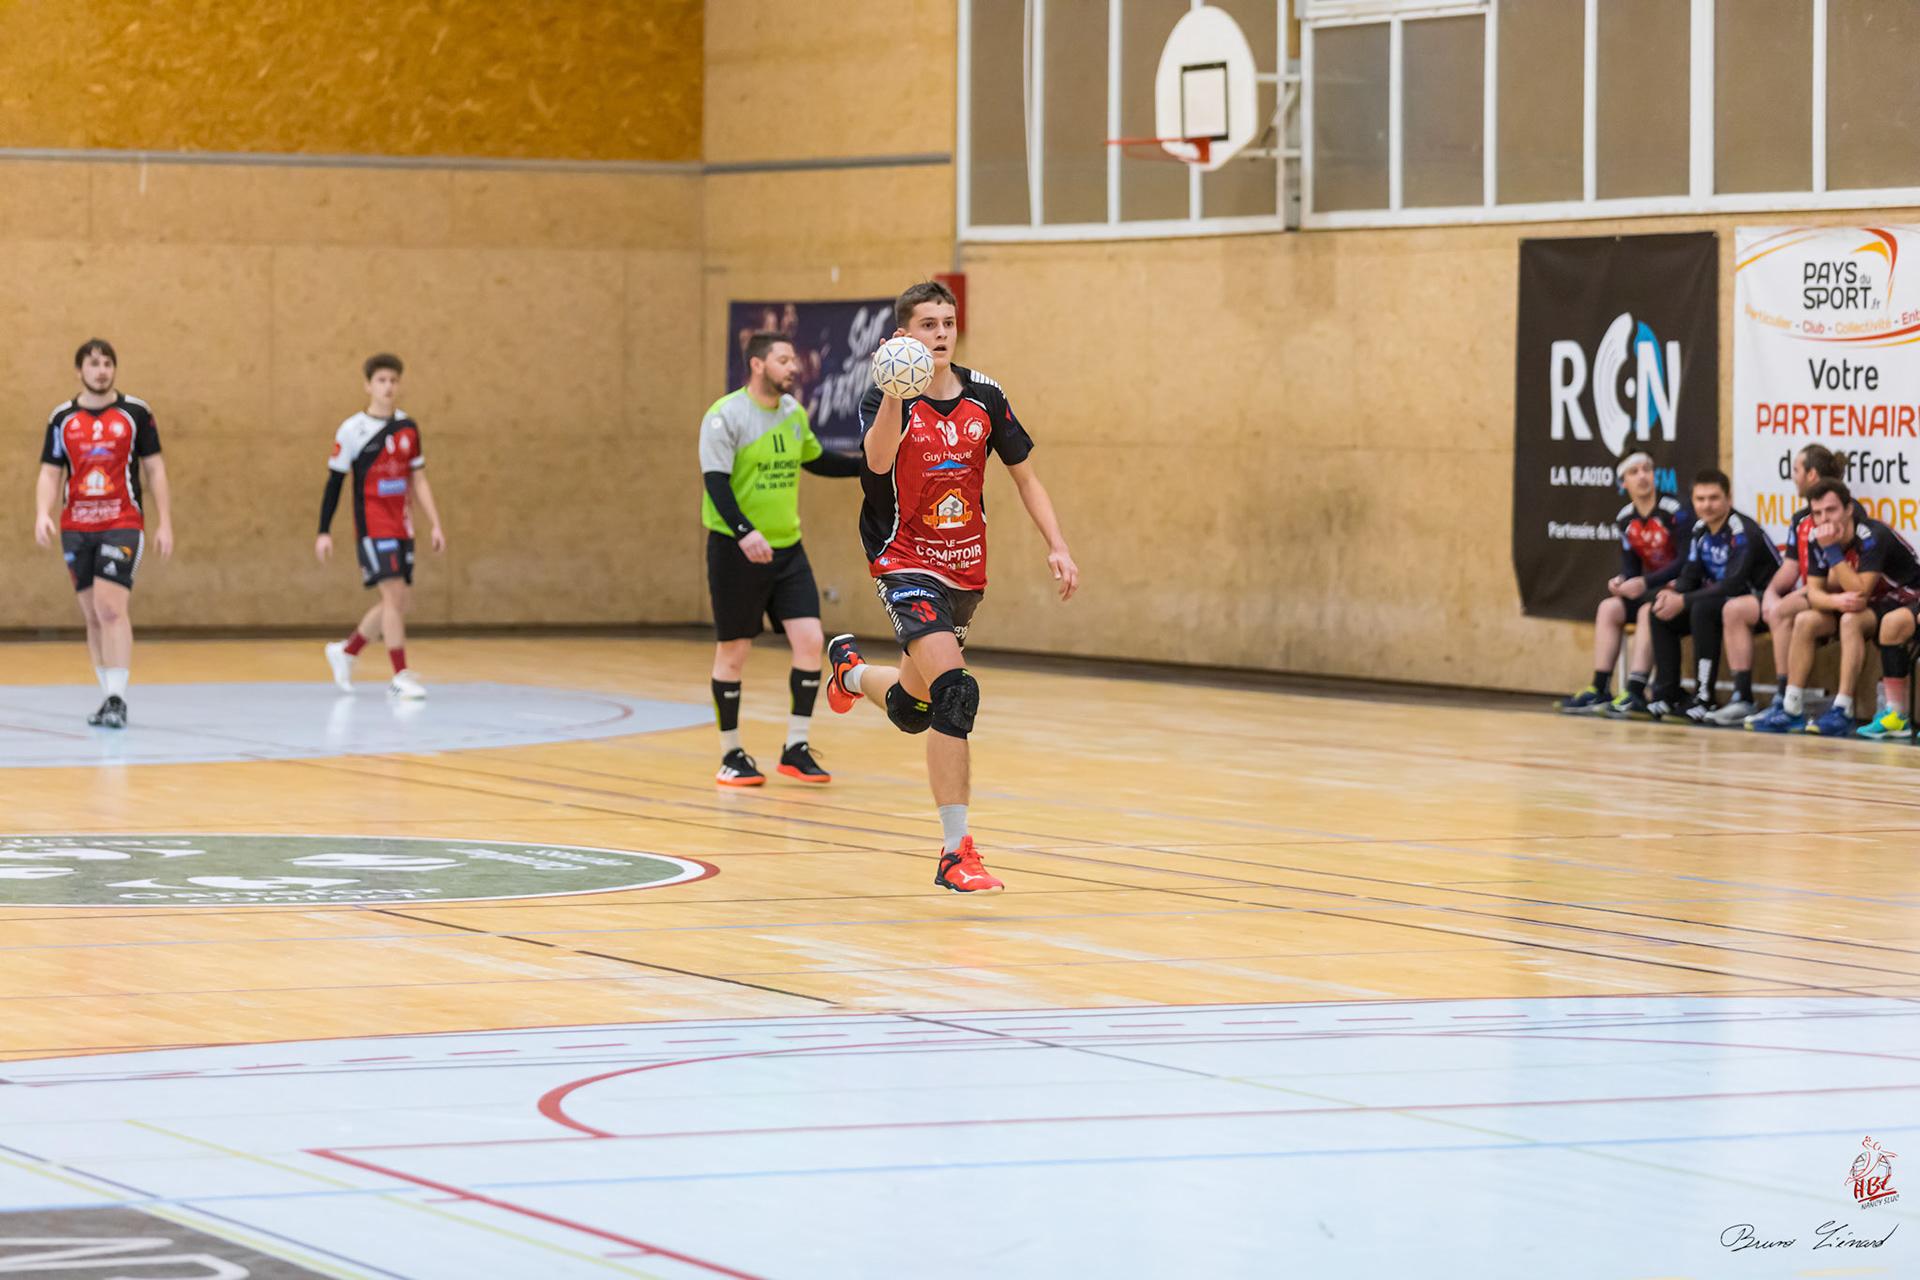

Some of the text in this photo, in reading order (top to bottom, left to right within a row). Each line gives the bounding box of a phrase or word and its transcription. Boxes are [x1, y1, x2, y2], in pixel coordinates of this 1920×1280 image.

[1803, 262, 1871, 285] PAYS du
[1802, 320, 1825, 335] Club
[1834, 317, 1892, 336] Collectivité
[1808, 358, 1879, 390] Votre
[92, 420, 104, 441] 2
[1756, 403, 1920, 438] PARTENAIR
[772, 433, 786, 453] 11
[935, 419, 959, 447] 18
[922, 451, 942, 463] Guy
[1550, 465, 1568, 486] LA
[1570, 465, 1613, 487] RADIO
[915, 543, 982, 561] COMPTOIR
[945, 539, 956, 548] LE
[892, 588, 920, 599] Grand
